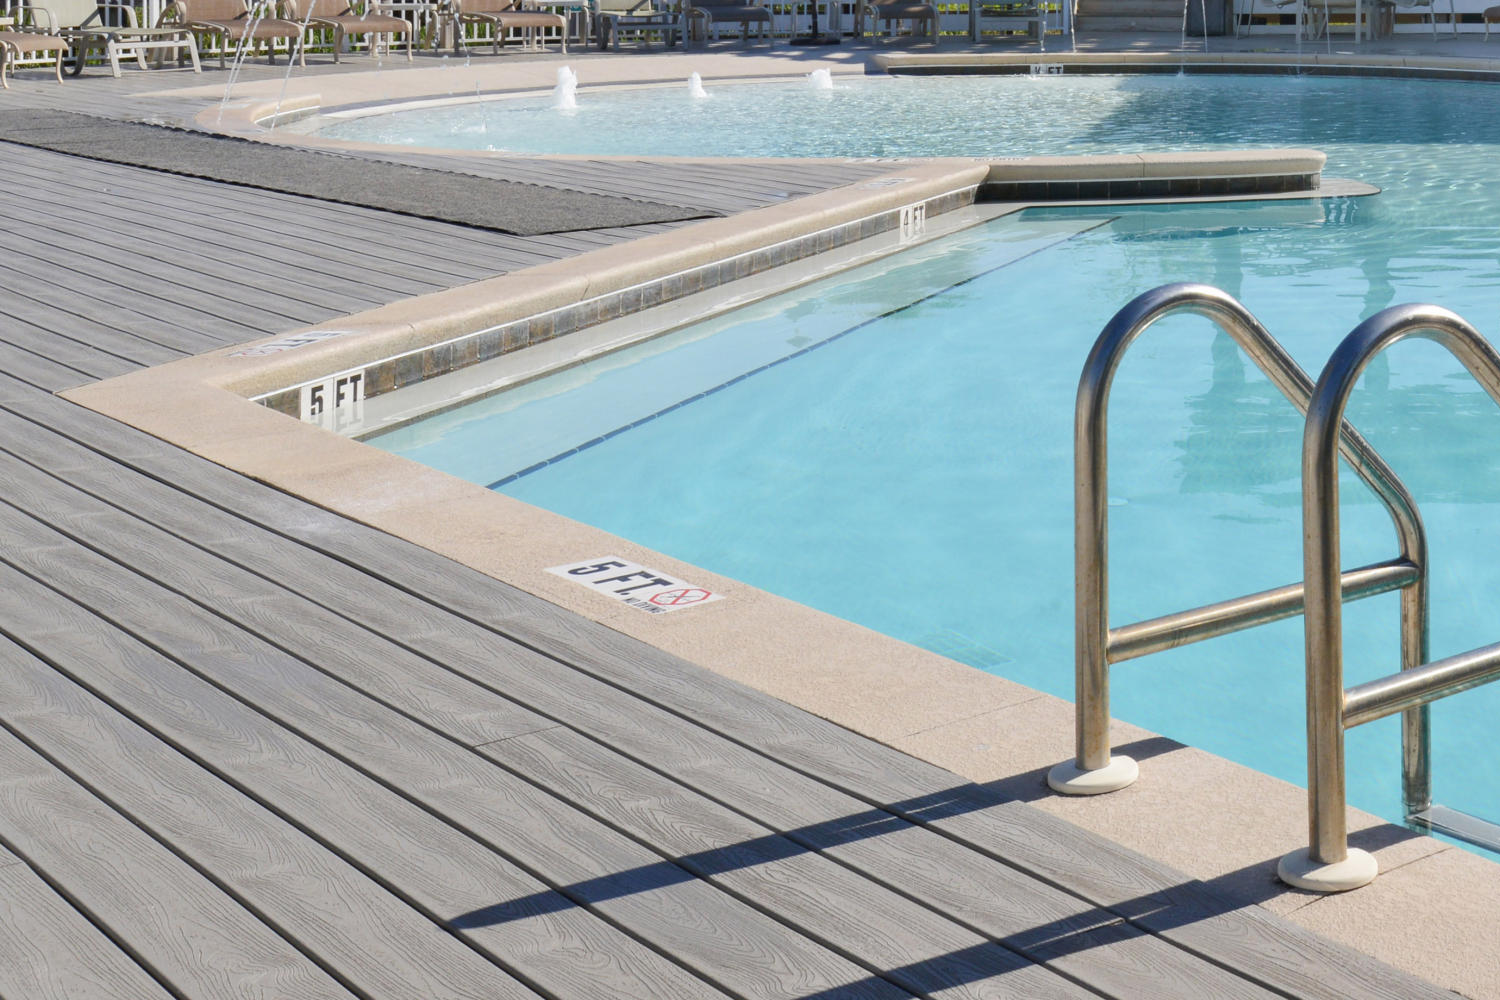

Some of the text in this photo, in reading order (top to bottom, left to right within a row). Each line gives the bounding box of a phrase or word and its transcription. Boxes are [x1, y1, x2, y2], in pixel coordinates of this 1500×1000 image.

[913, 205, 925, 223] FT
[310, 373, 362, 416] 5 FT
[567, 560, 674, 596] 5 FT.
